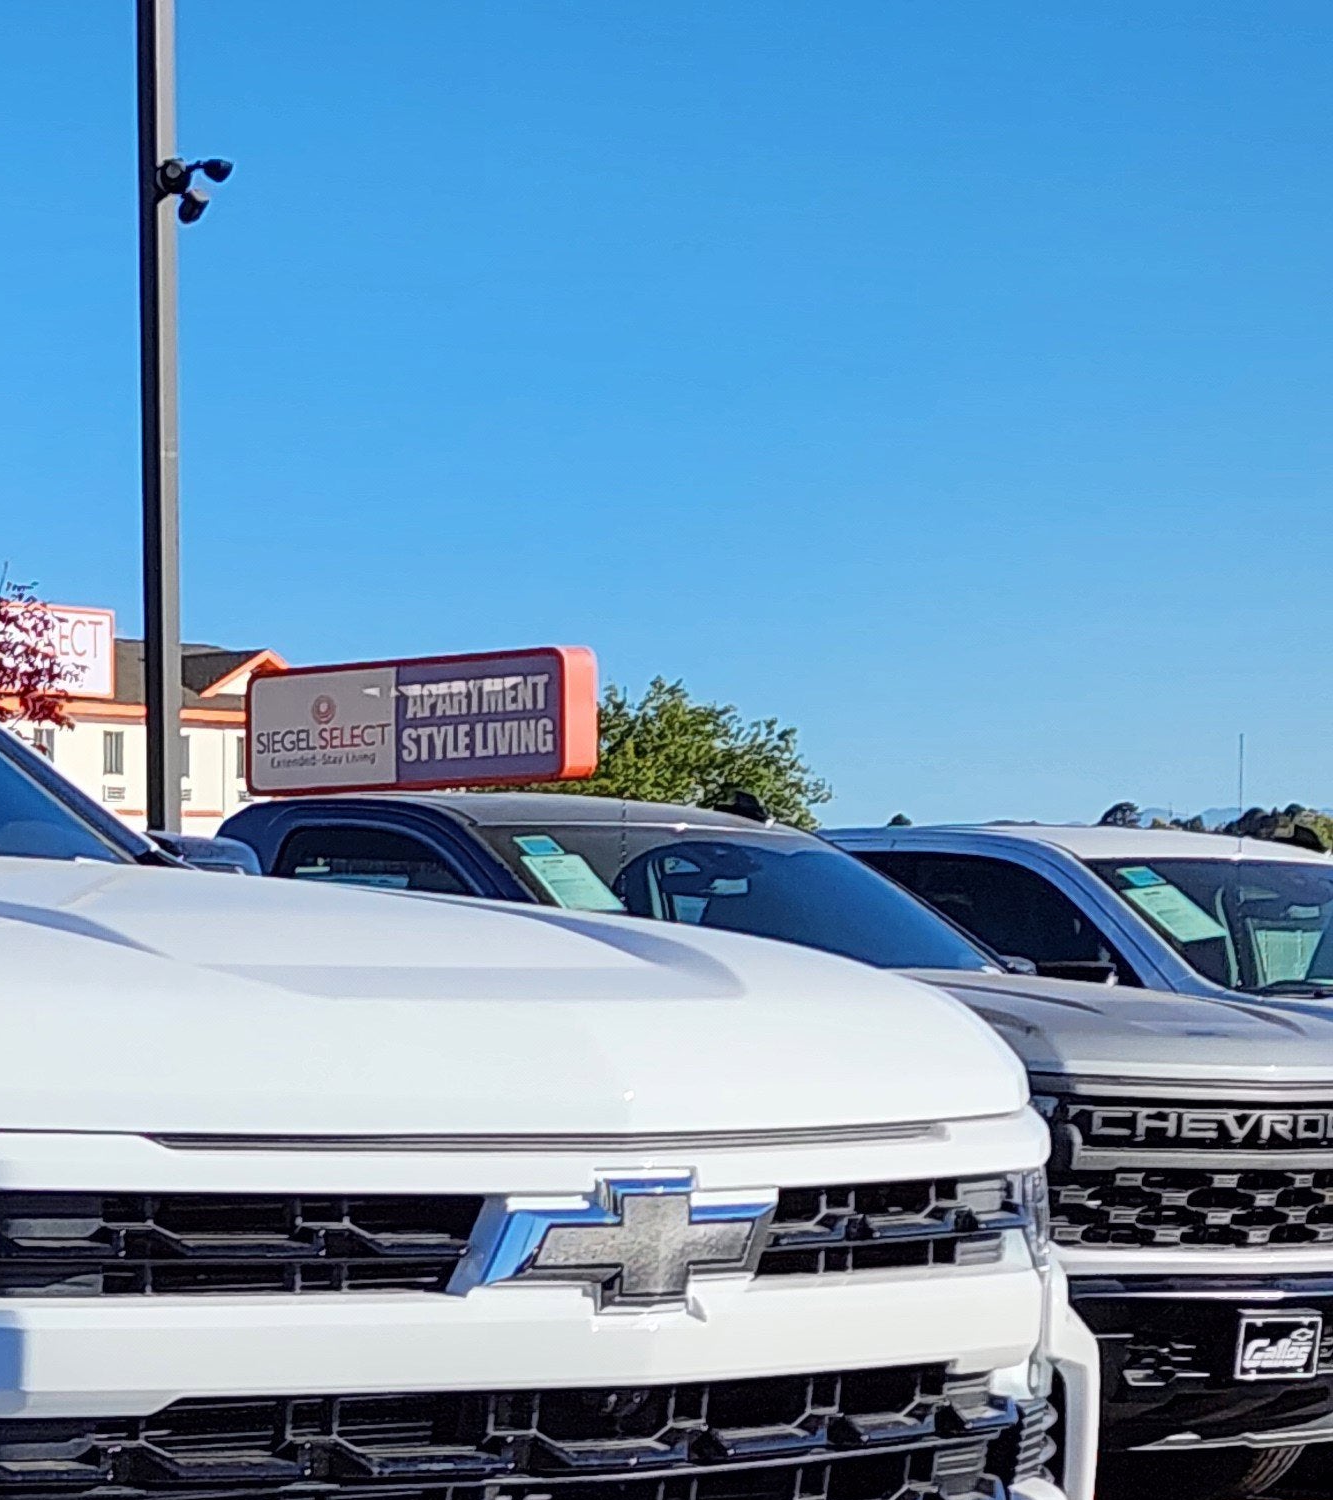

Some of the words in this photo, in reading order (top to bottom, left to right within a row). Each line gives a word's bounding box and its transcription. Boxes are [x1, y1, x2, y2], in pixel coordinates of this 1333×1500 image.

[405, 673, 550, 720] APARTMENT
[256, 729, 317, 755] SIEGEL
[318, 723, 392, 750] SELECT
[402, 722, 470, 763] STYLE
[474, 718, 554, 758] LIVING
